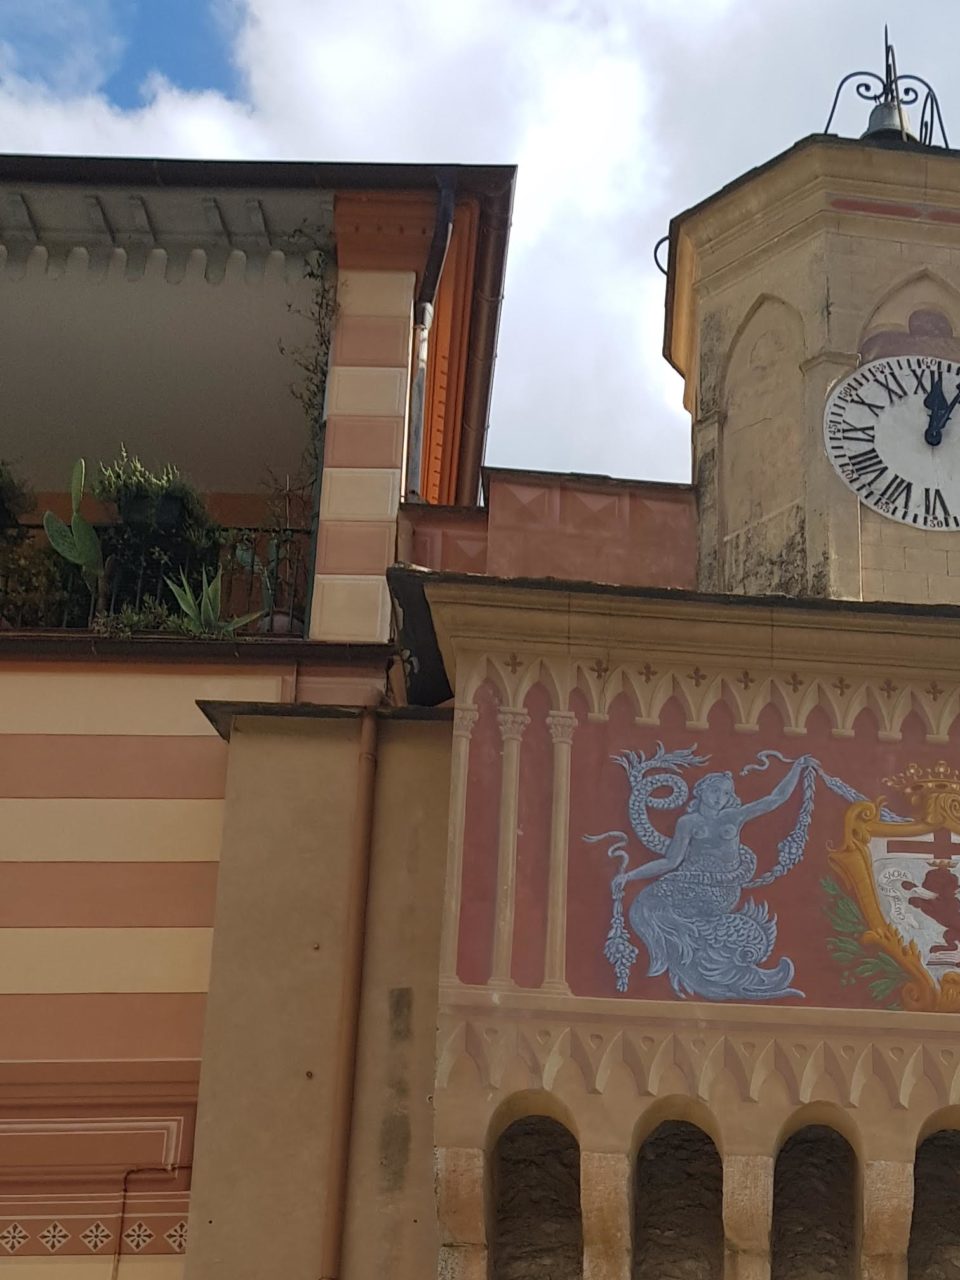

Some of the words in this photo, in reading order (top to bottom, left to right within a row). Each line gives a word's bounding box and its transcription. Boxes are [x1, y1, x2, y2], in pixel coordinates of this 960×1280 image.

[873, 371, 909, 404] XI
[849, 393, 886, 418] X
[842, 419, 876, 443] IX
[848, 447, 889, 489] VIII
[880, 473, 914, 511] VII
[924, 488, 951, 517] VI
